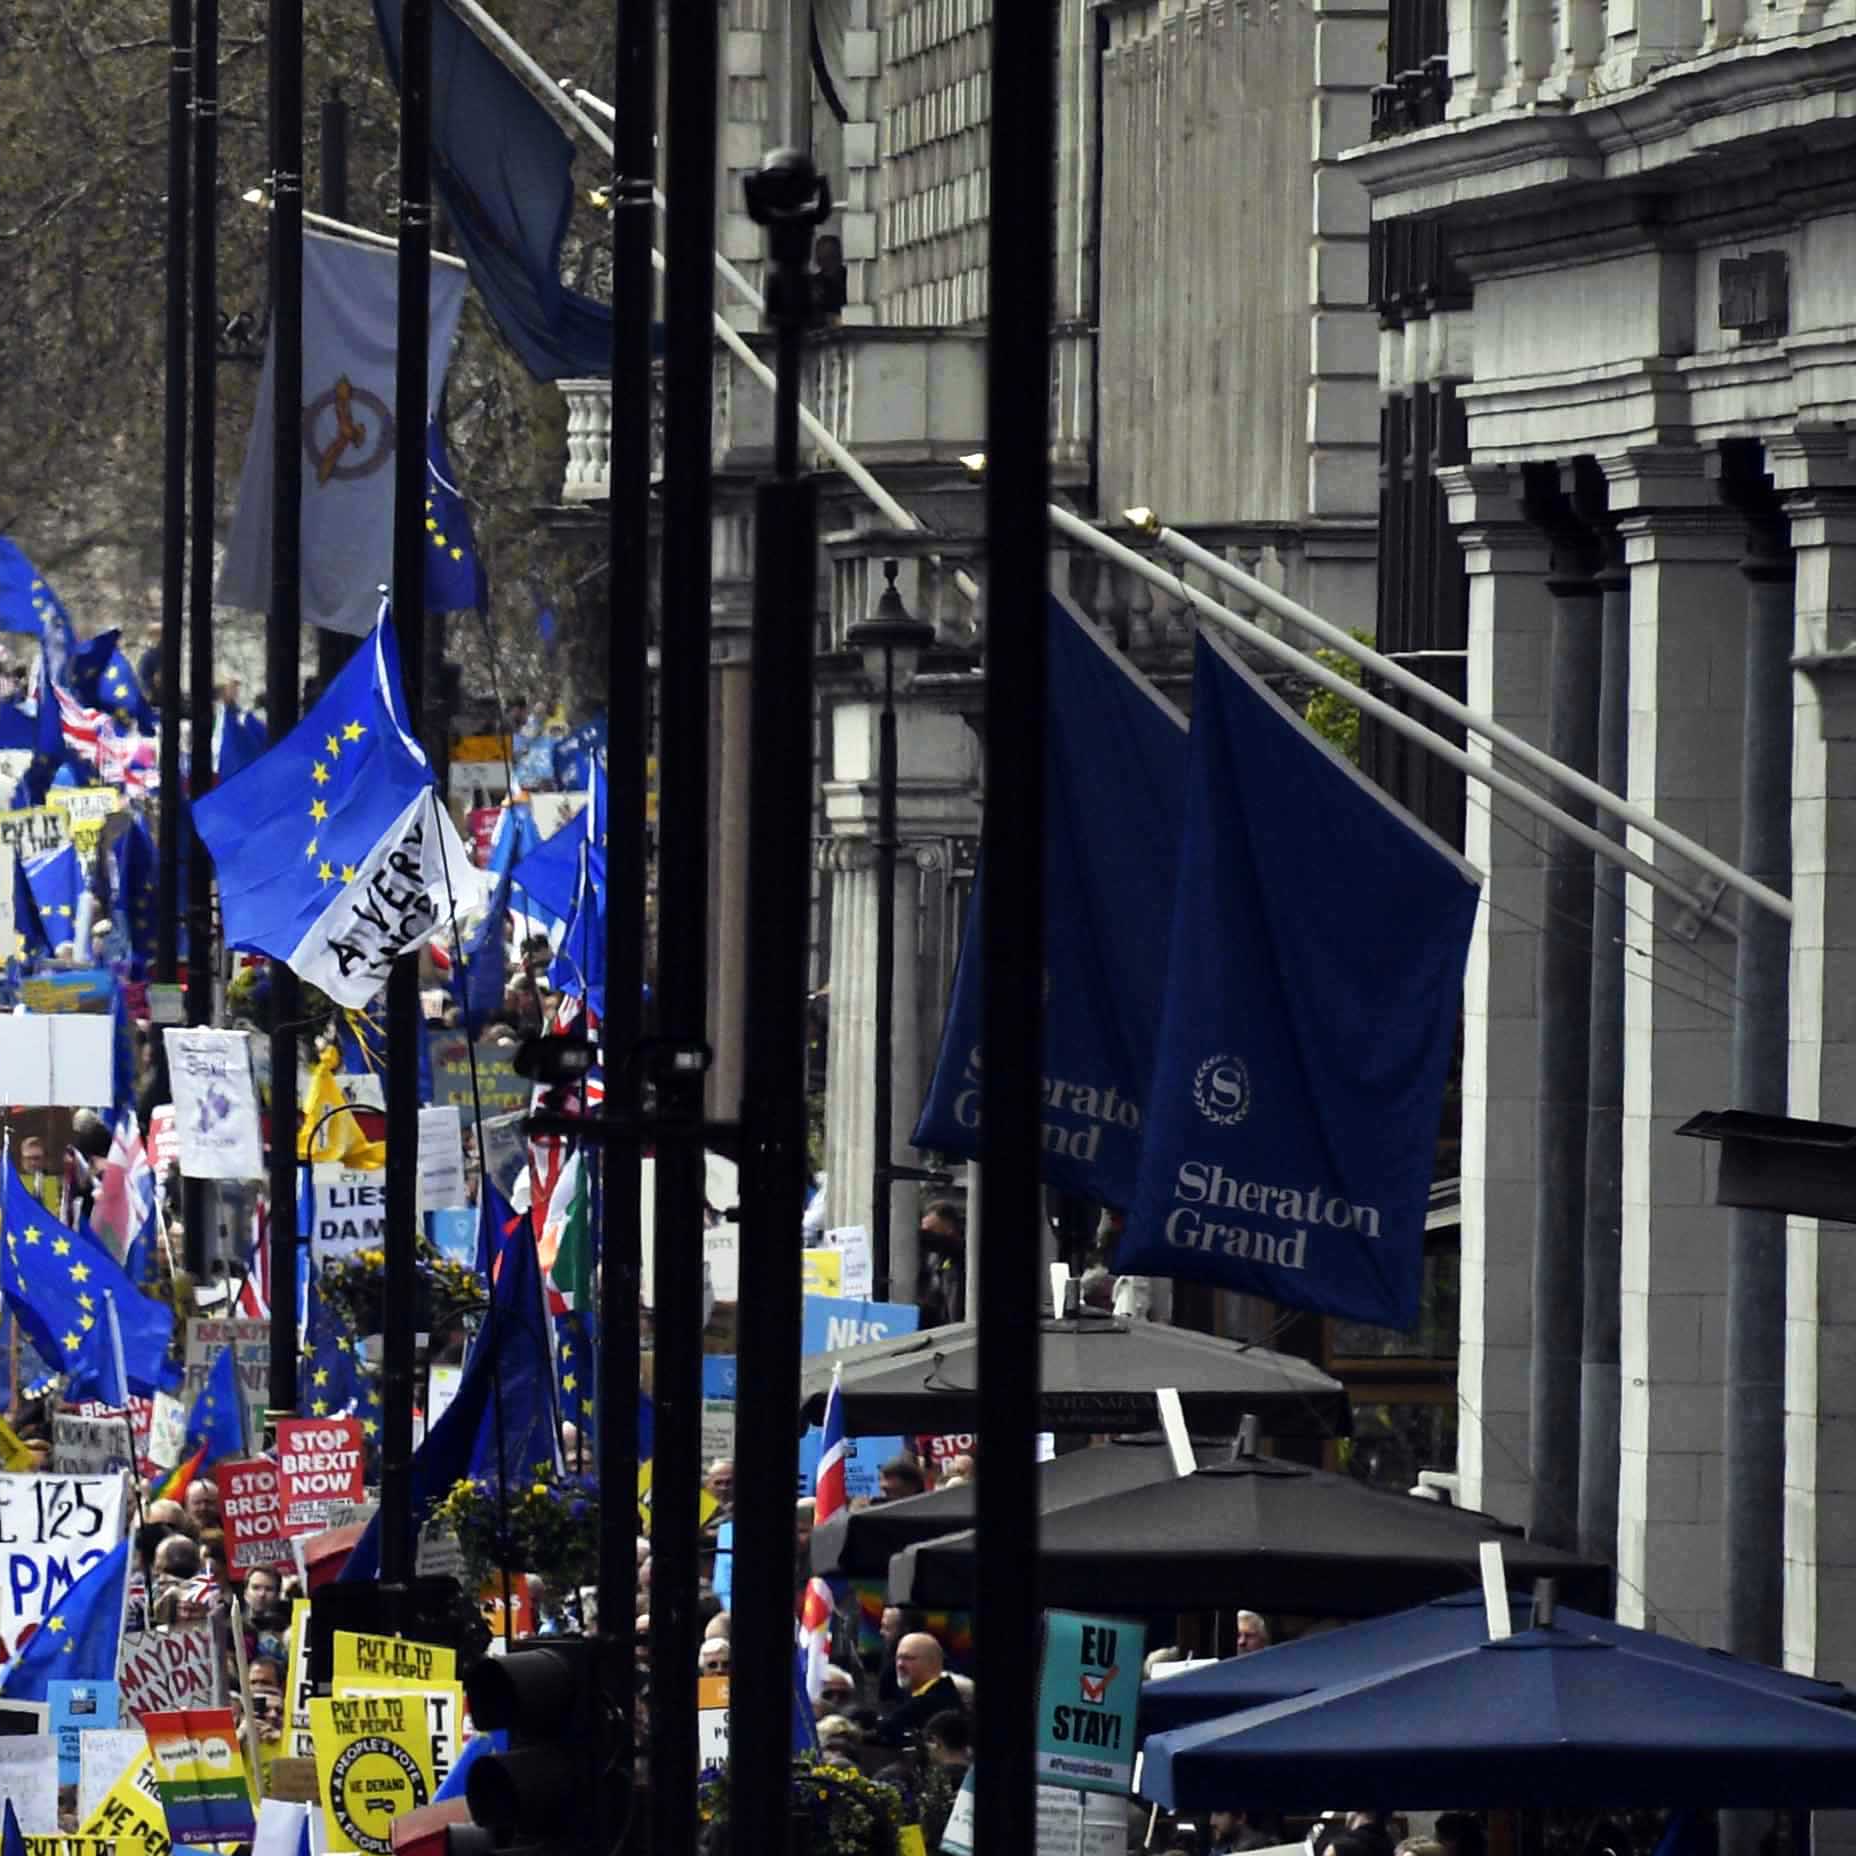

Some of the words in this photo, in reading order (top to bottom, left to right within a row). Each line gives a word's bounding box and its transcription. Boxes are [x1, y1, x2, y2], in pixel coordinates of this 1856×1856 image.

[1173, 1159, 1381, 1241] Sheraton
[1165, 1208, 1308, 1271] Grand
[289, 1430, 349, 1451] STOP
[282, 1451, 359, 1474] BREXIT
[292, 1473, 352, 1494] NOW
[1082, 1626, 1117, 1668] EU
[1052, 1705, 1121, 1749] STAY!
